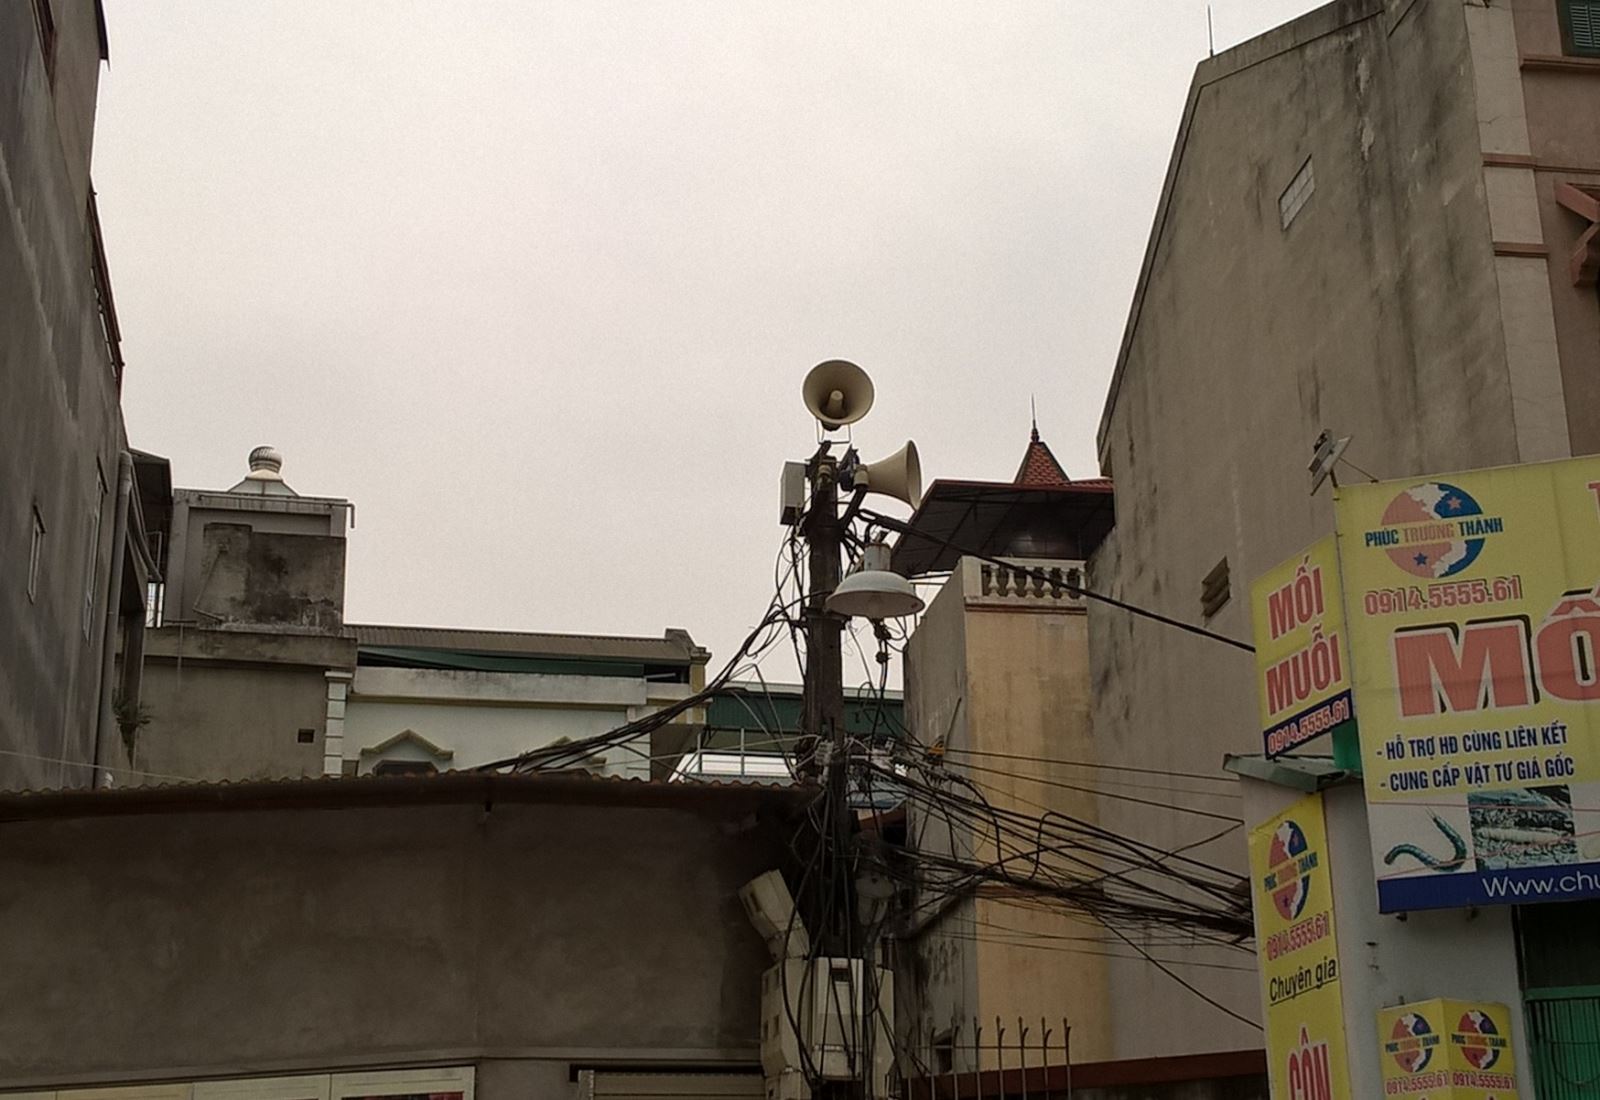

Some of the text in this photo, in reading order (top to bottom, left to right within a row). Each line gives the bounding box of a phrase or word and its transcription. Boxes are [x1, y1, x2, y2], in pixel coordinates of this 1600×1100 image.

[1365, 528, 1400, 547] PHÚC
[1458, 517, 1504, 537] THÀNH
[1268, 555, 1325, 640] MỐI
[1364, 576, 1522, 616] 0914.5555.61
[1266, 623, 1342, 716] MUỖI
[1268, 697, 1350, 755] 0914.5555.61
[1408, 736, 1435, 760] TRỢ
[1439, 736, 1458, 754] HĐ
[1463, 730, 1501, 752] CÙNG
[1506, 725, 1537, 748] LIÊN
[1542, 720, 1567, 746] KẾT
[1390, 770, 1428, 791] CUNG
[1432, 762, 1460, 787] CẤP
[1464, 763, 1490, 788] VẬT
[1494, 761, 1513, 781] TƯ
[1517, 756, 1541, 779] GIÁ
[1545, 752, 1574, 777] GỐC
[1269, 955, 1337, 1002] Chuyên gia
